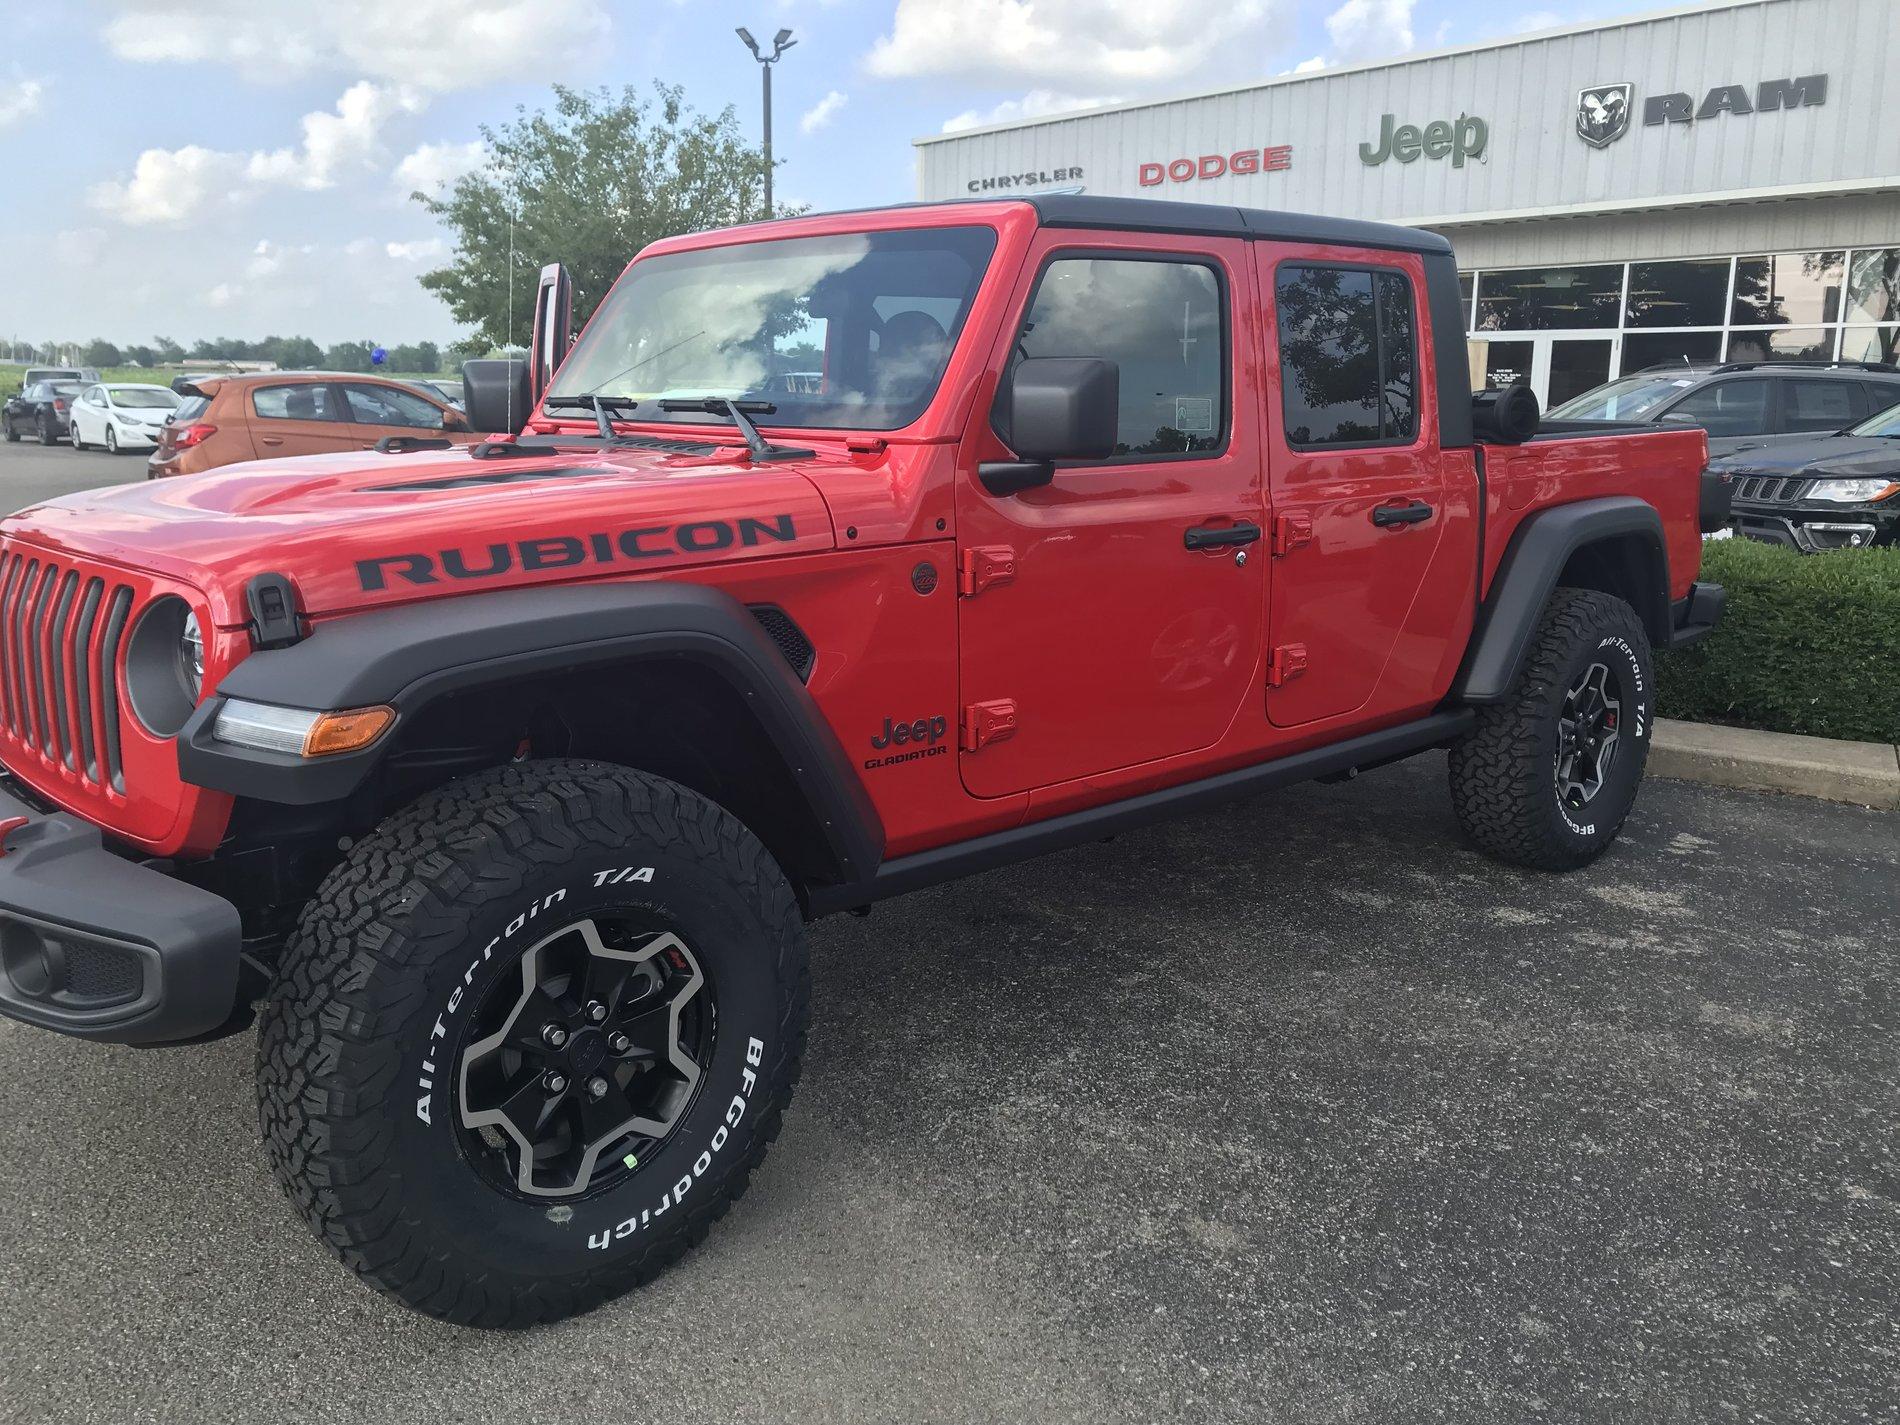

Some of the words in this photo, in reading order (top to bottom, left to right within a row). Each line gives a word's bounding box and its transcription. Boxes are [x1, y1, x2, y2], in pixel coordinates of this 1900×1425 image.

[1643, 73, 1829, 127] RAM
[1138, 144, 1293, 187] DODGE
[1358, 111, 1489, 168] Jeep
[967, 165, 1085, 193] CHRYSLER
[355, 513, 798, 592] RUBICON
[1598, 636, 1643, 692] All-Terrain
[1636, 702, 1646, 737] T/A
[863, 744, 948, 770] GLADIATOR
[870, 714, 947, 750] Jeep
[415, 887, 567, 1128] All-Terrain
[592, 866, 656, 888] T/A
[586, 1036, 765, 1251] BFGoodrich
